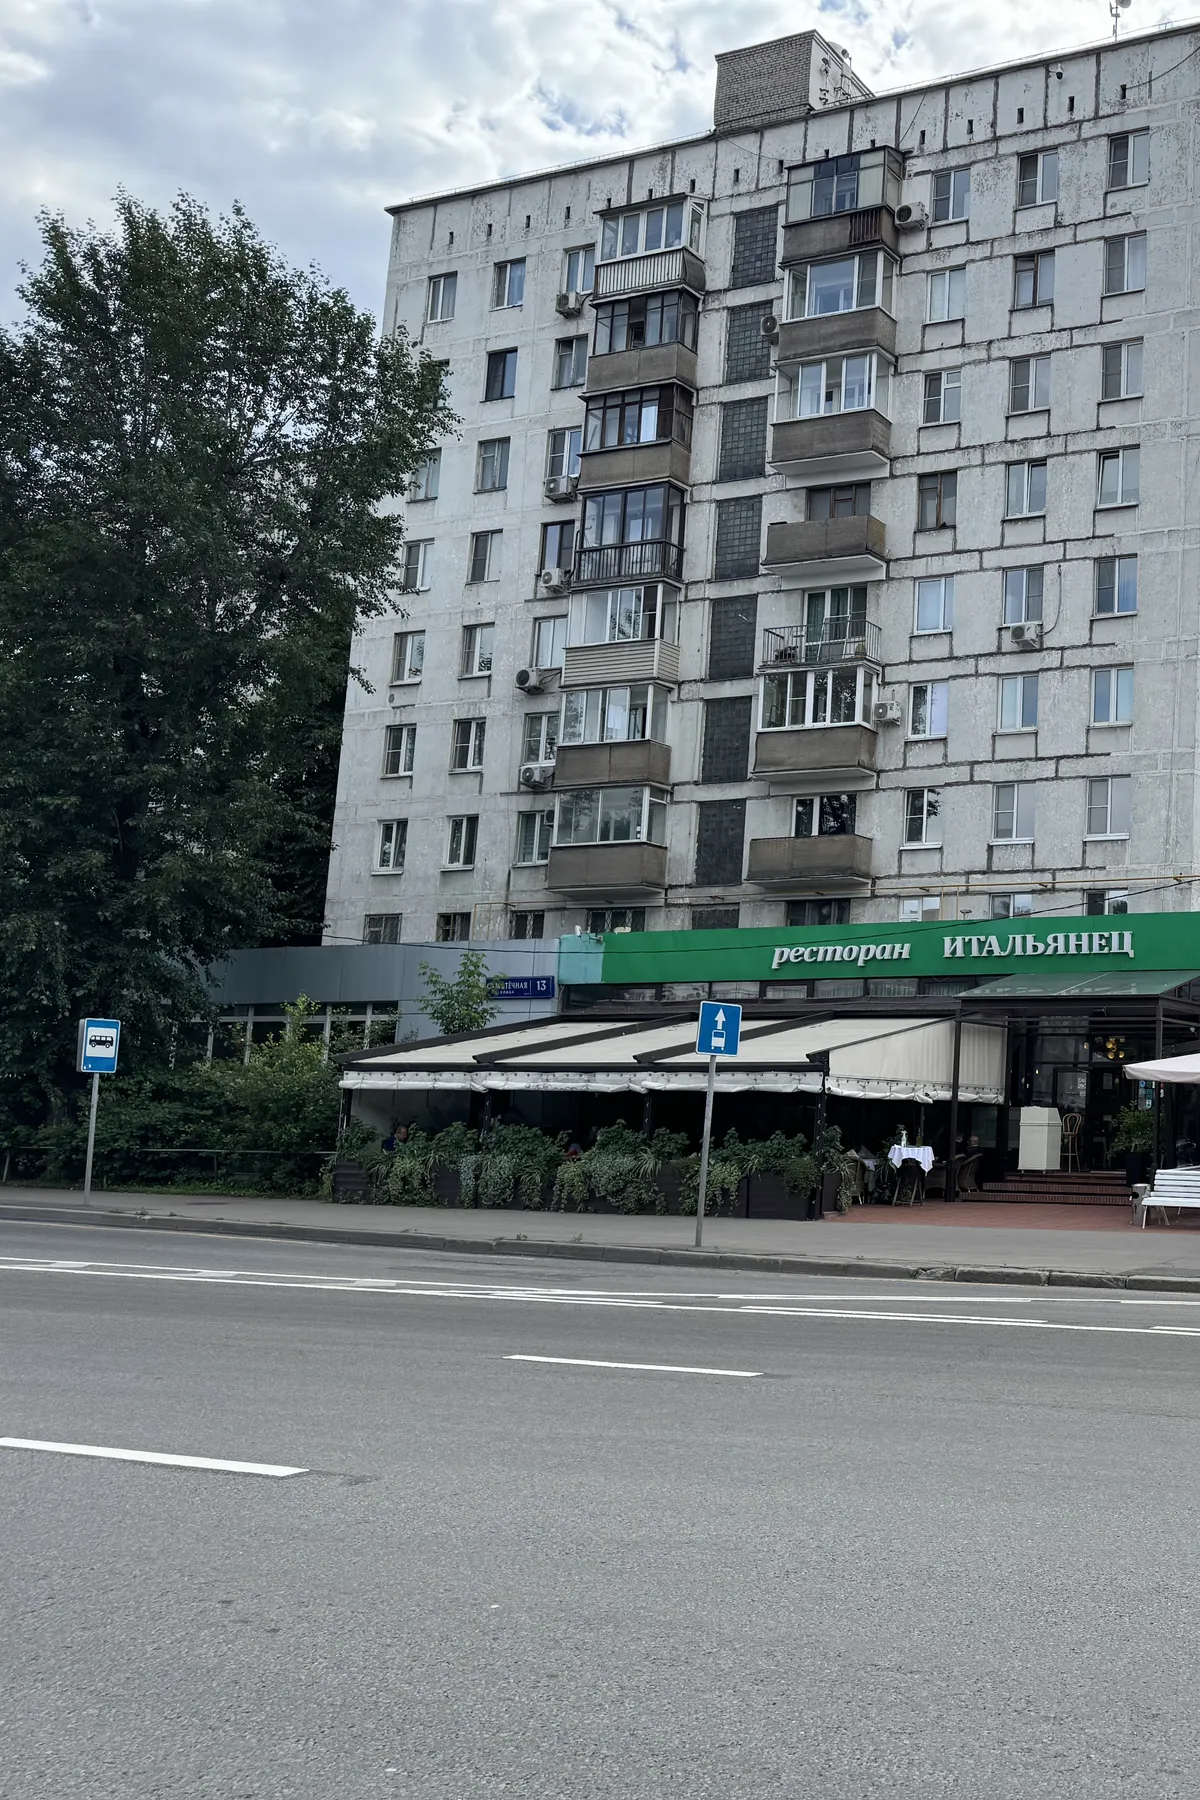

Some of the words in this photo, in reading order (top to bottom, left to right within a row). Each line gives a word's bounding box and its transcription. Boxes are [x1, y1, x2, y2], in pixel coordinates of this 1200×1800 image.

[772, 943, 911, 969] ресторан
[942, 931, 1135, 958] ИТАЛЬЯНЕЦ
[536, 980, 547, 991] 13
